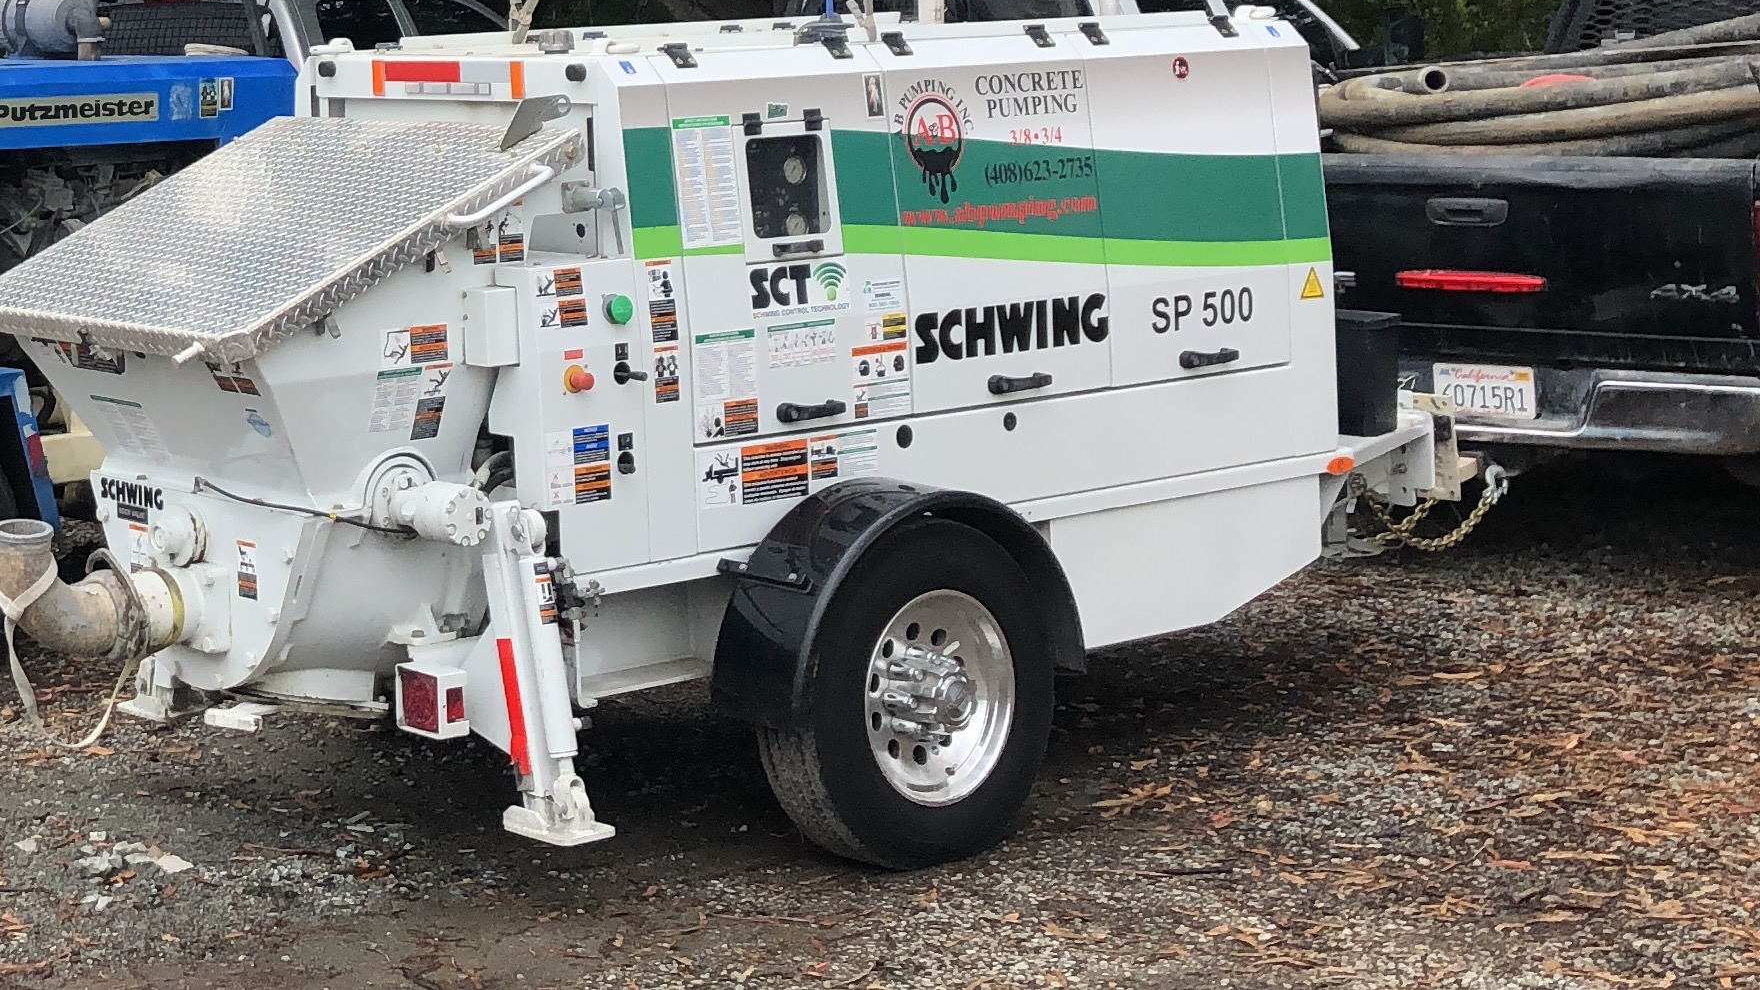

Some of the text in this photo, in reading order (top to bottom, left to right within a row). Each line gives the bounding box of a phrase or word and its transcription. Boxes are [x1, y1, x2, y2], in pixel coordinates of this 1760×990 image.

[899, 79, 956, 111] PUMPING
[975, 69, 1084, 96] CONCRETE
[986, 93, 1078, 118] PUMPING
[984, 155, 1093, 189] (408)623-2735
[902, 194, 1097, 228] www.abpumping.com
[749, 263, 812, 310] SCT
[810, 303, 850, 313] TECHNOLOGY
[1151, 286, 1254, 335] SP 500
[914, 292, 1110, 365] SCHWING
[1453, 368, 1510, 383] California
[100, 476, 164, 511] SCHWING
